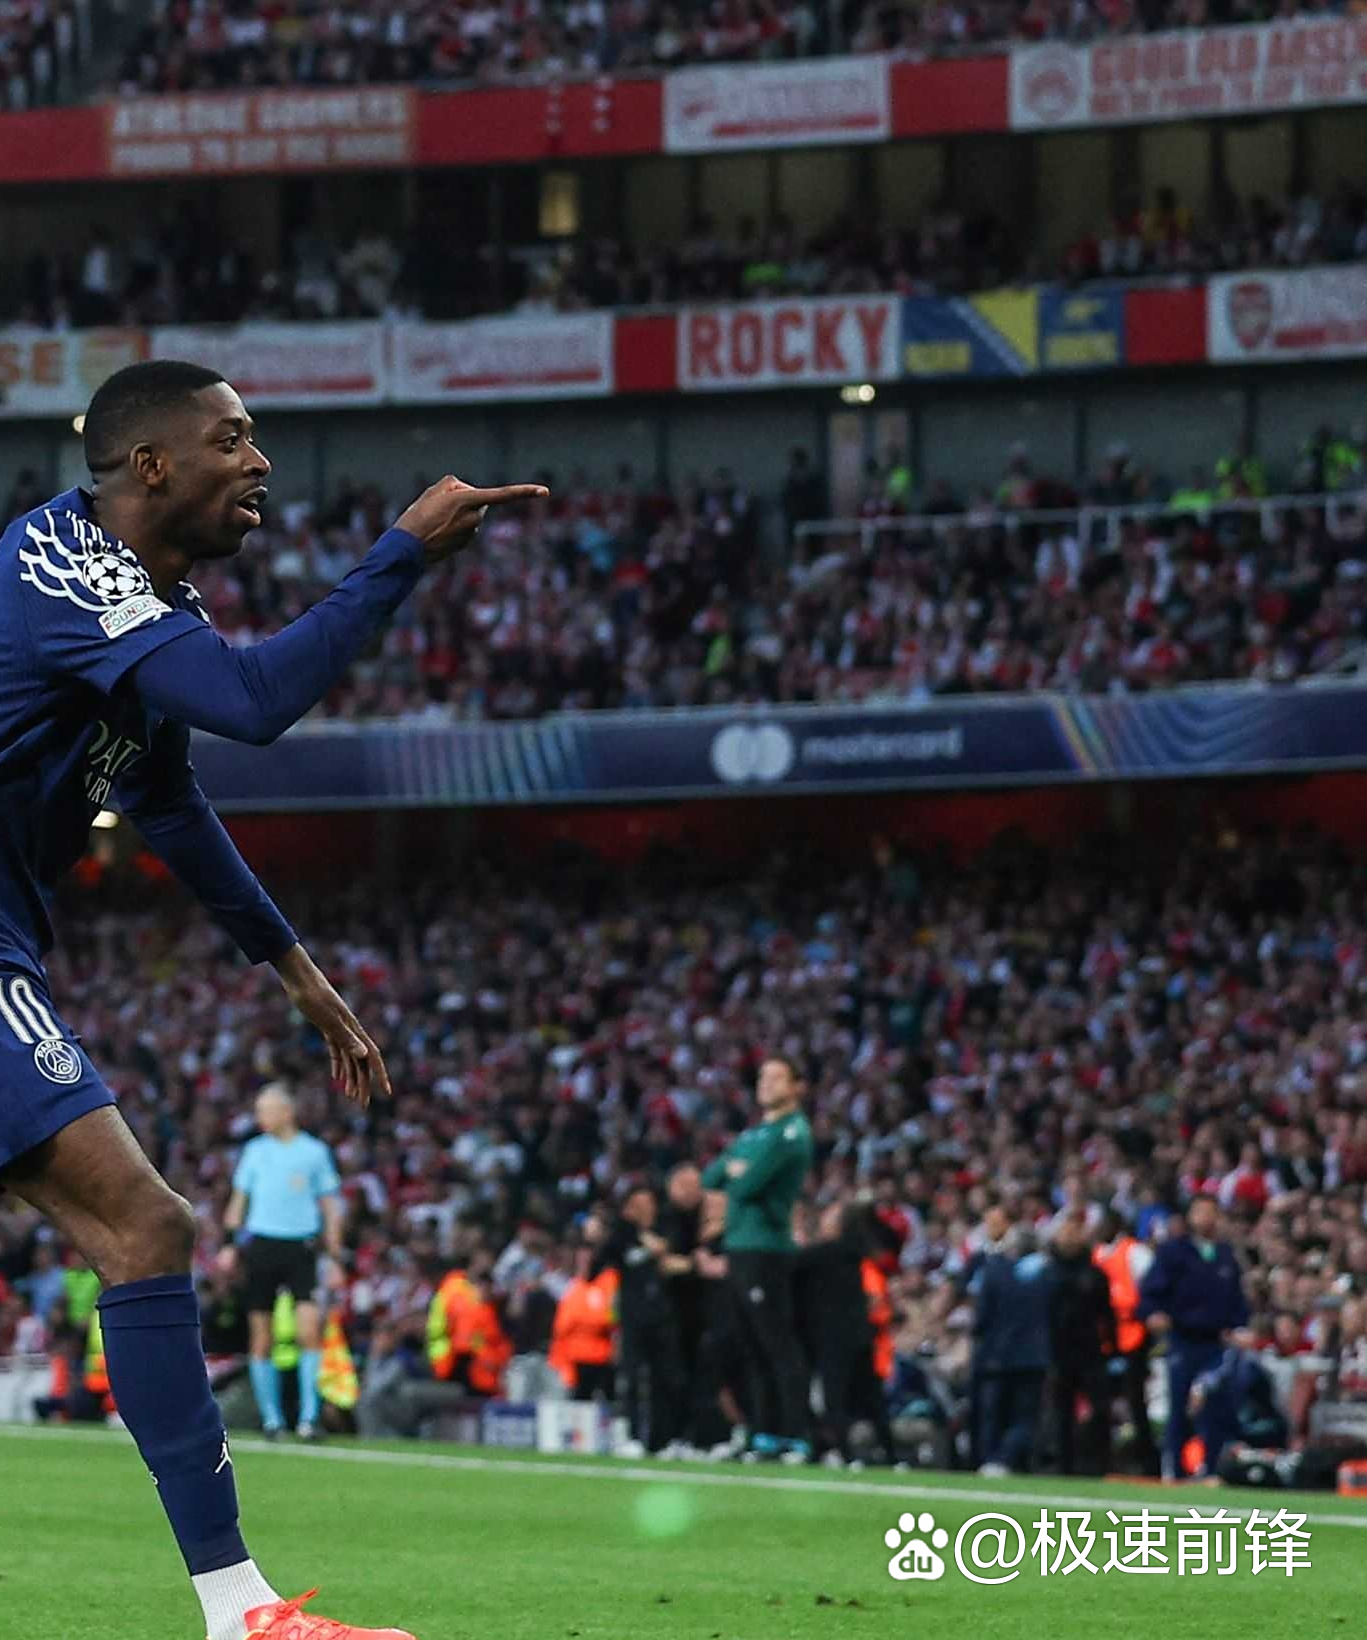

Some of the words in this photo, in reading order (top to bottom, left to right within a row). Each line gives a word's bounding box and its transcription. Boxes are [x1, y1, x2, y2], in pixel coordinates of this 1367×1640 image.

[689, 304, 891, 378] ROCKY
[803, 728, 963, 764] mastercard
[37, 1041, 64, 1058] PARIS
